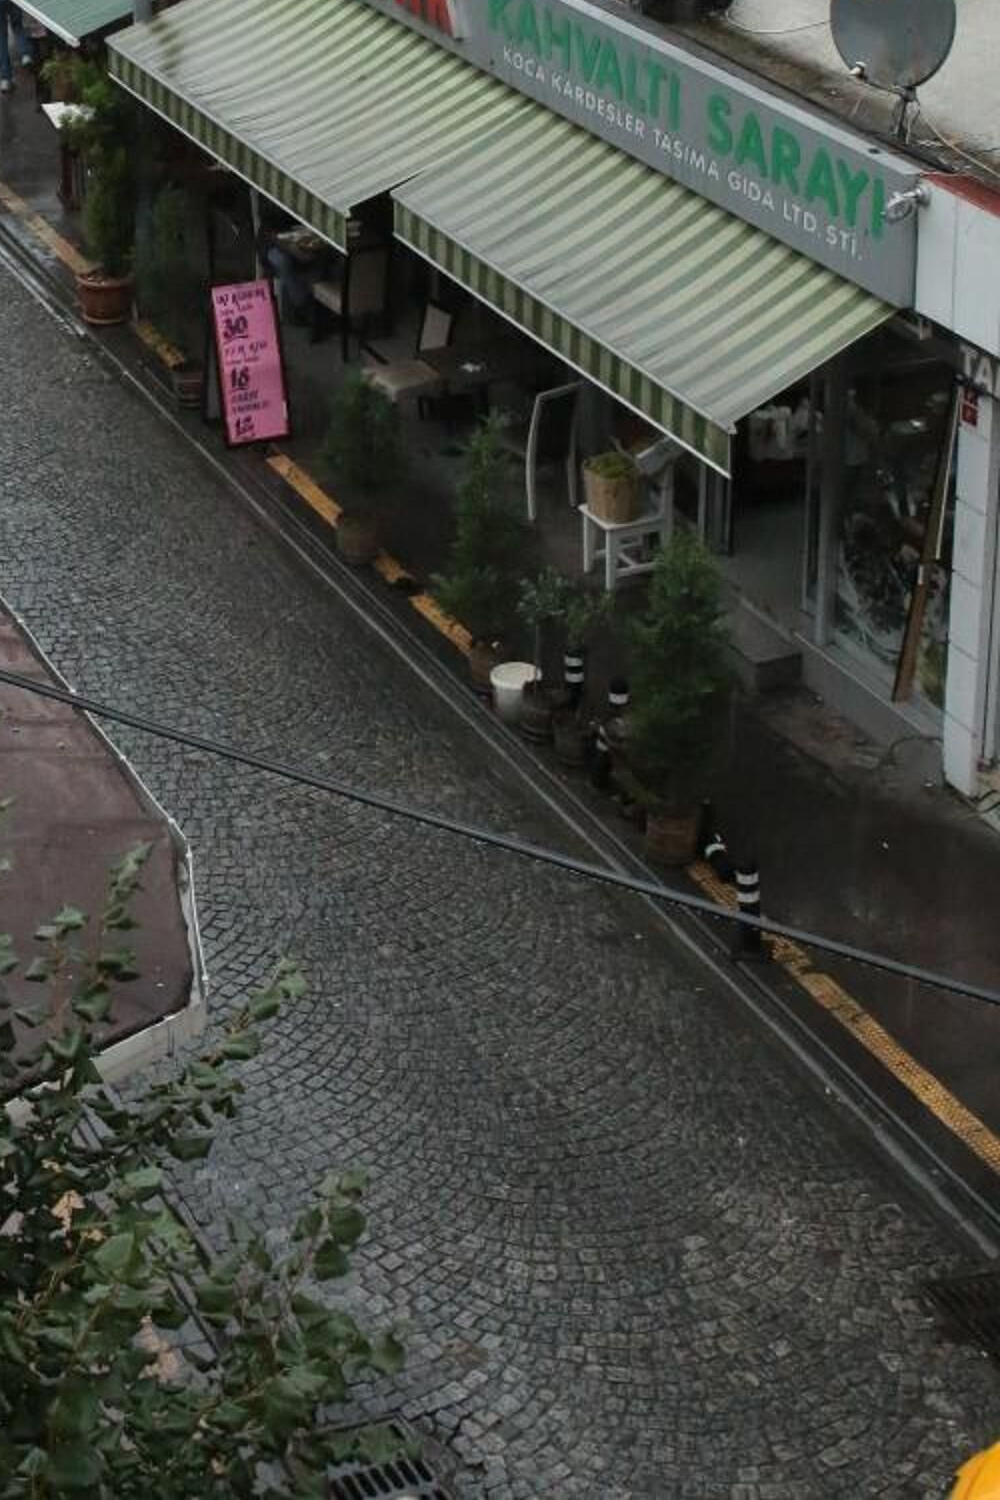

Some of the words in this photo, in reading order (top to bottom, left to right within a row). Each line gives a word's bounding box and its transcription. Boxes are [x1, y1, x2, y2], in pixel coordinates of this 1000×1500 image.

[502, 44, 546, 86] KOCA
[727, 170, 775, 212] GIDA
[706, 90, 886, 242] SARAYI
